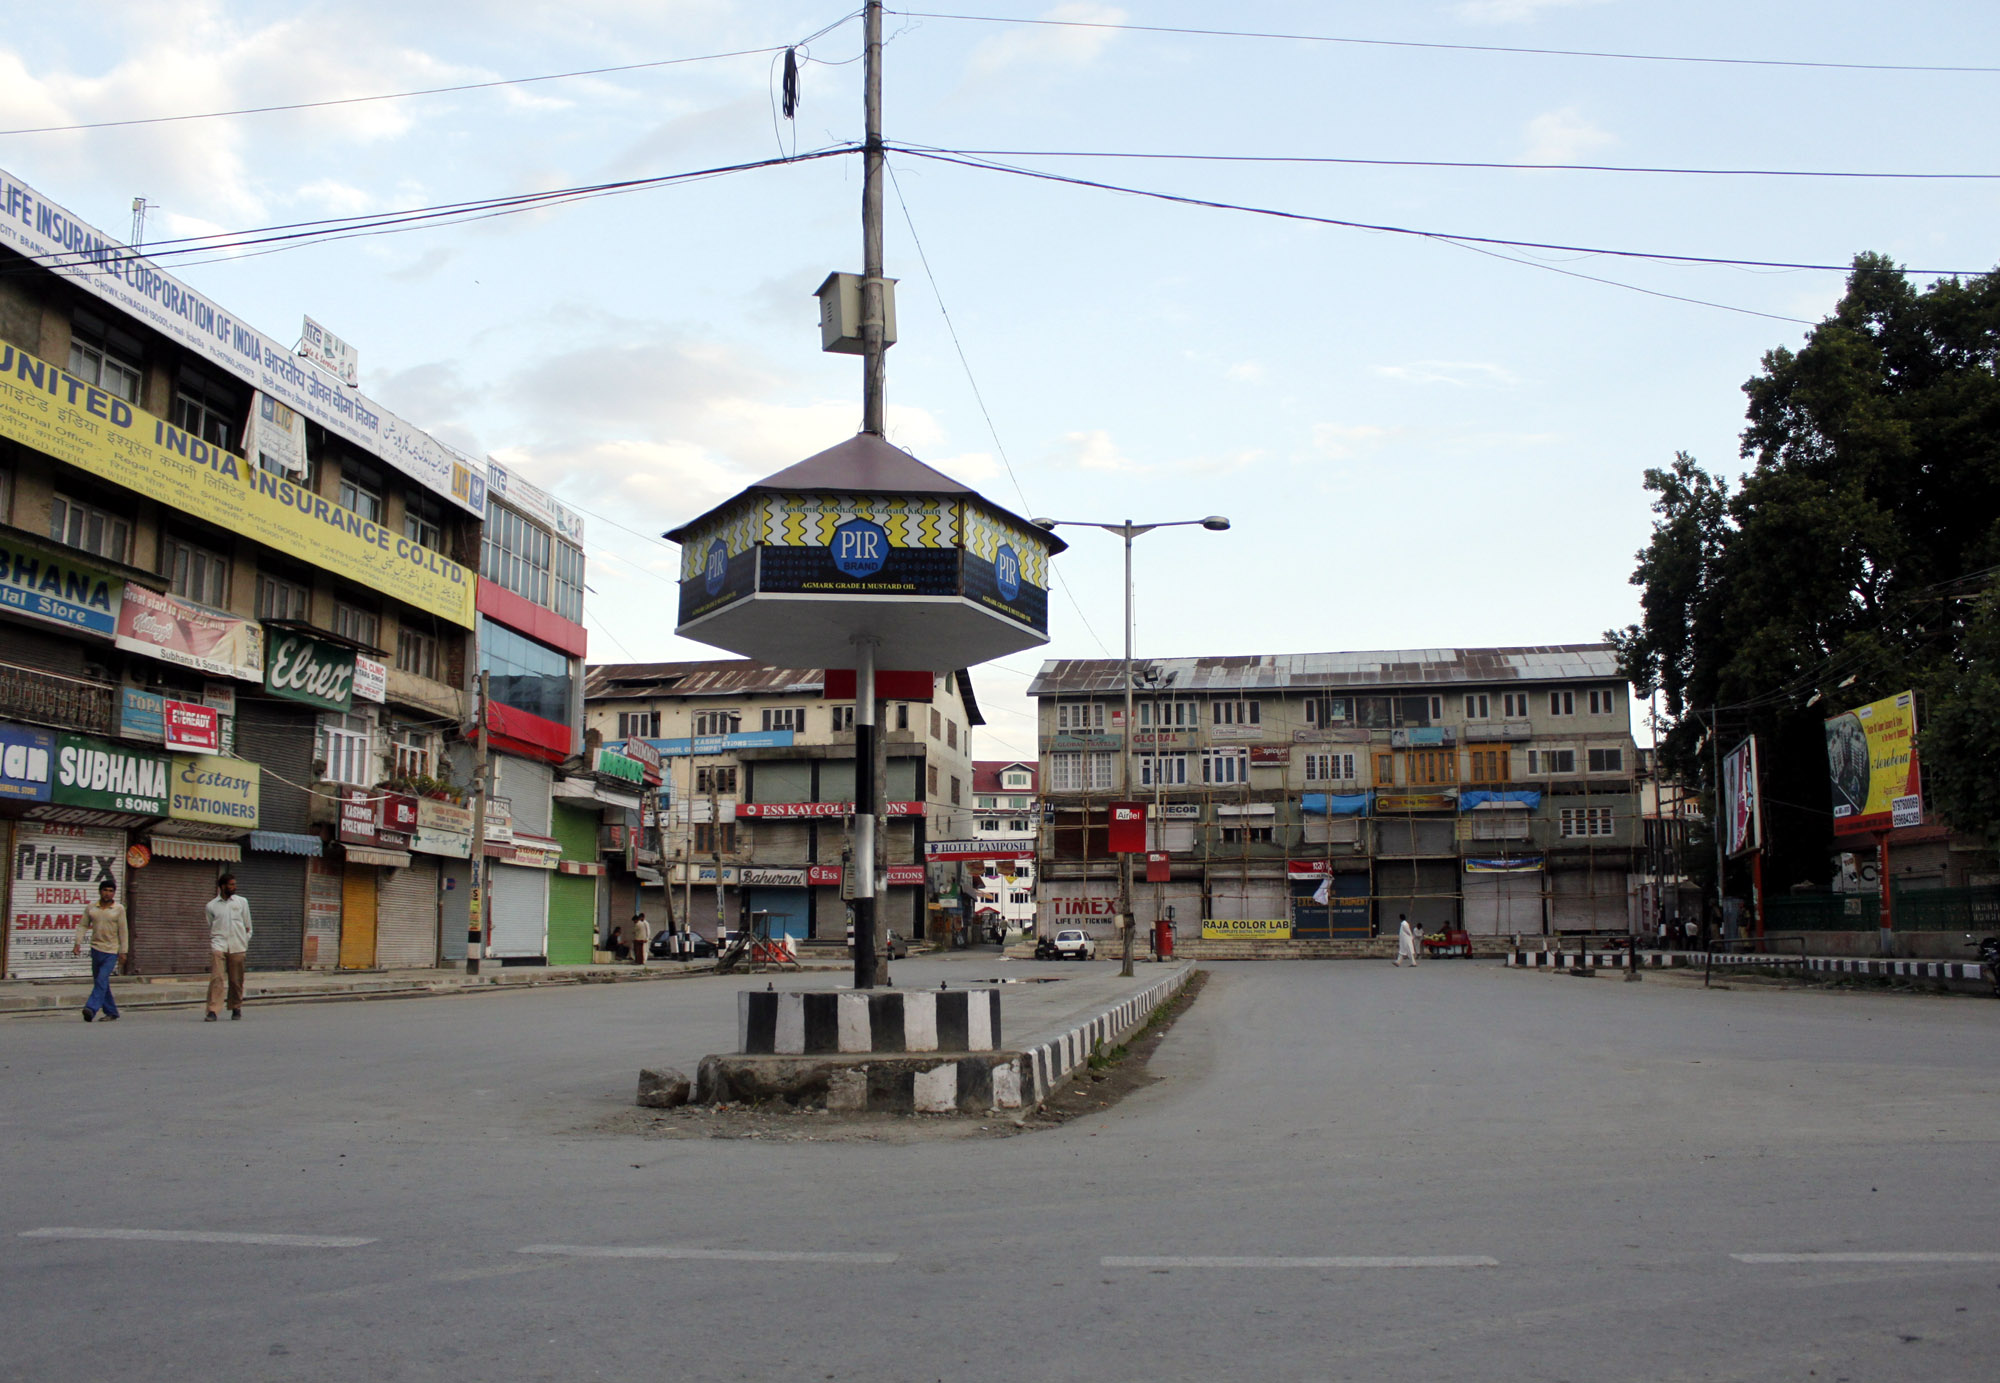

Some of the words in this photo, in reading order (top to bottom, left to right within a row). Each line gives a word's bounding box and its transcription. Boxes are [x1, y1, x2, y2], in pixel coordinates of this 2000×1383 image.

[0, 178, 33, 227] LIFE
[37, 201, 123, 281] INSURANCE
[126, 259, 214, 336] CORPORATION
[217, 313, 231, 344] OF
[233, 323, 262, 366] INDIA
[275, 404, 291, 430] LIC
[155, 420, 240, 481] INDIA
[453, 465, 468, 497] LIC
[780, 504, 820, 514] Kashmir
[832, 505, 863, 514] Shaan
[866, 505, 905, 515] Wazwan
[840, 531, 879, 559] PIR
[708, 549, 724, 581] PIR
[843, 562, 879, 571] BRAND
[999, 553, 1017, 586] PIR
[37, 596, 87, 624] Store
[123, 587, 147, 605] Great
[147, 597, 168, 613] start
[168, 603, 177, 616] to
[160, 648, 194, 666] Subhana
[194, 657, 202, 667] &
[202, 660, 220, 672] Sons
[271, 637, 353, 702] Elrex
[172, 709, 212, 729] EVEREADY
[1133, 733, 1178, 743] GLOBAL
[59, 746, 168, 799] SUBHANA
[181, 761, 251, 799] Ecstasy
[22, 805, 150, 828] SUBHANA
[115, 797, 123, 808] &
[124, 798, 160, 814] SONS
[173, 794, 256, 819] STATIONERS
[344, 803, 372, 821] KASHMIR
[763, 805, 785, 816] ESS
[788, 804, 814, 816] KAY
[1117, 811, 1140, 820] Airtel
[43, 823, 85, 836] EXTRA
[941, 843, 977, 852] HOTEL
[979, 842, 1027, 852] PAMPOSH
[36, 888, 91, 905] HERBAL
[1052, 897, 1119, 915] TIMEX
[1203, 920, 1229, 929] RAJA
[1232, 920, 1266, 929] COLOR
[1269, 920, 1289, 929] LAB
